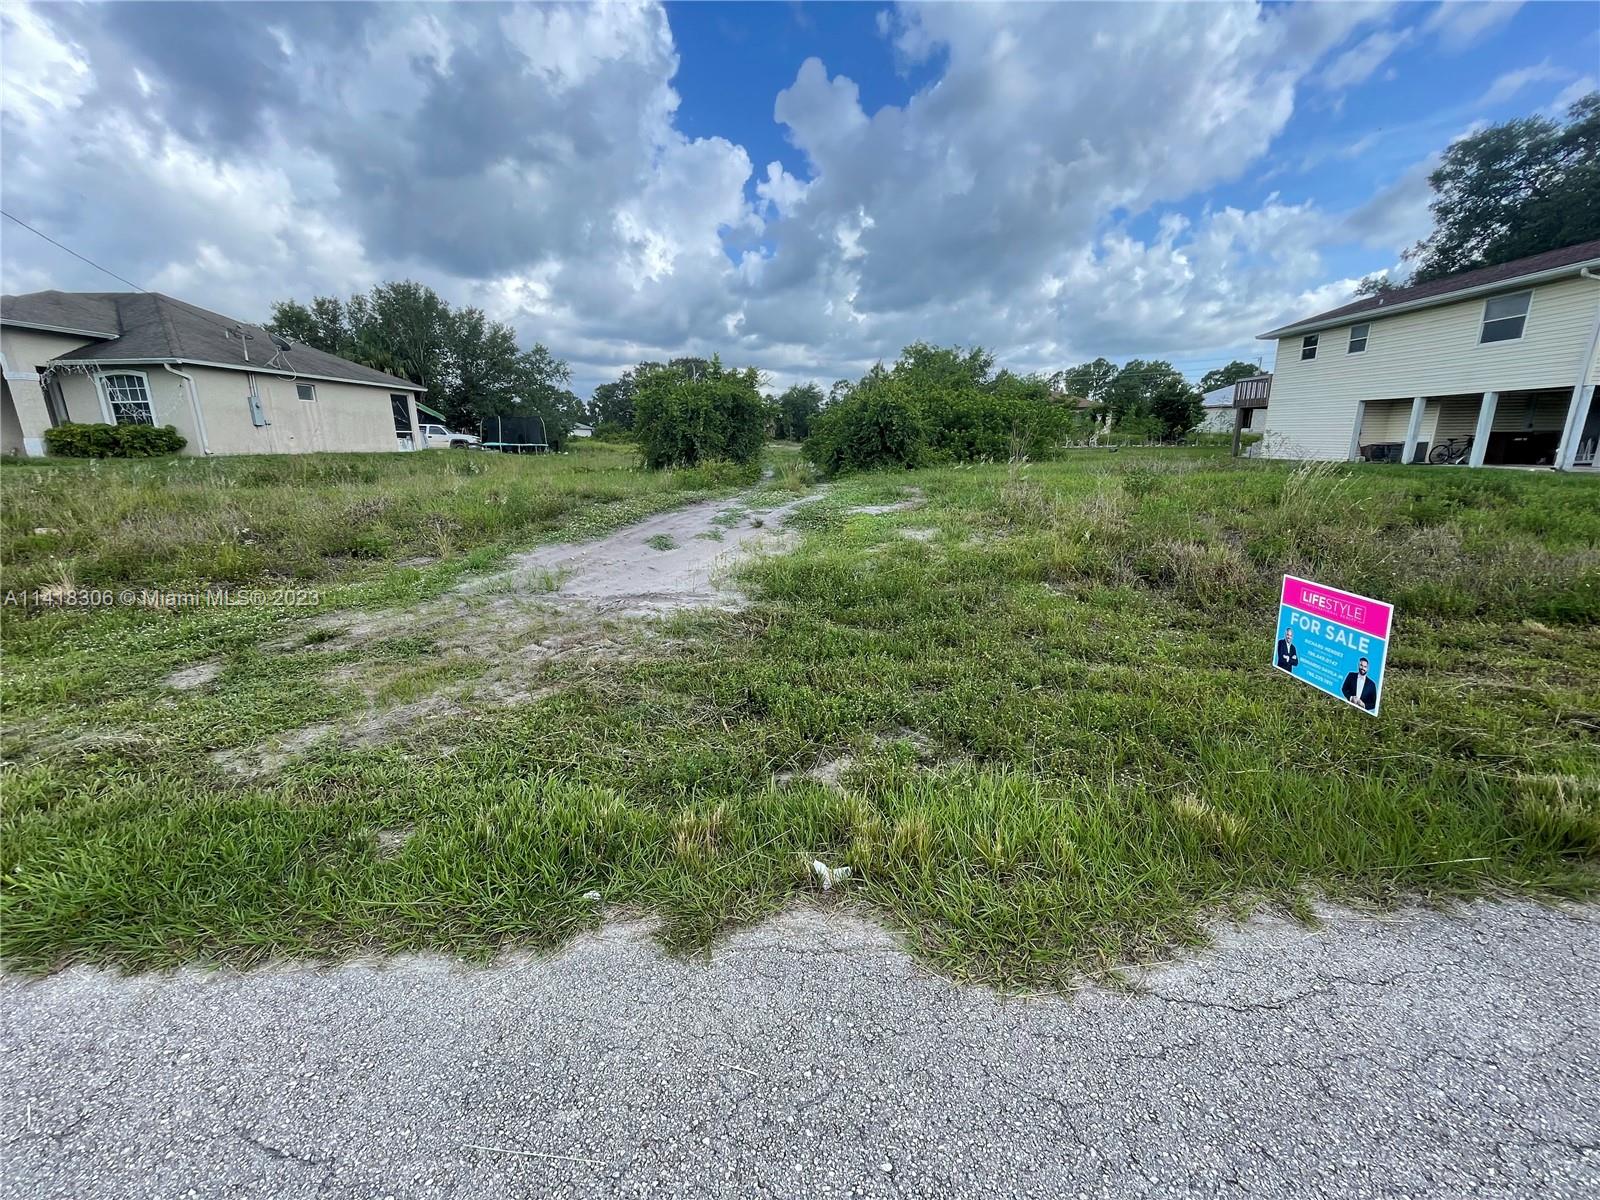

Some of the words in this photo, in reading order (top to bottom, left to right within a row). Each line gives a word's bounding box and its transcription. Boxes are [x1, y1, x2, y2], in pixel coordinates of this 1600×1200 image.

[1302, 590, 1363, 620] LIFESTYLE
[1290, 612, 1321, 635] FOR
[1325, 625, 1370, 654] SALE
